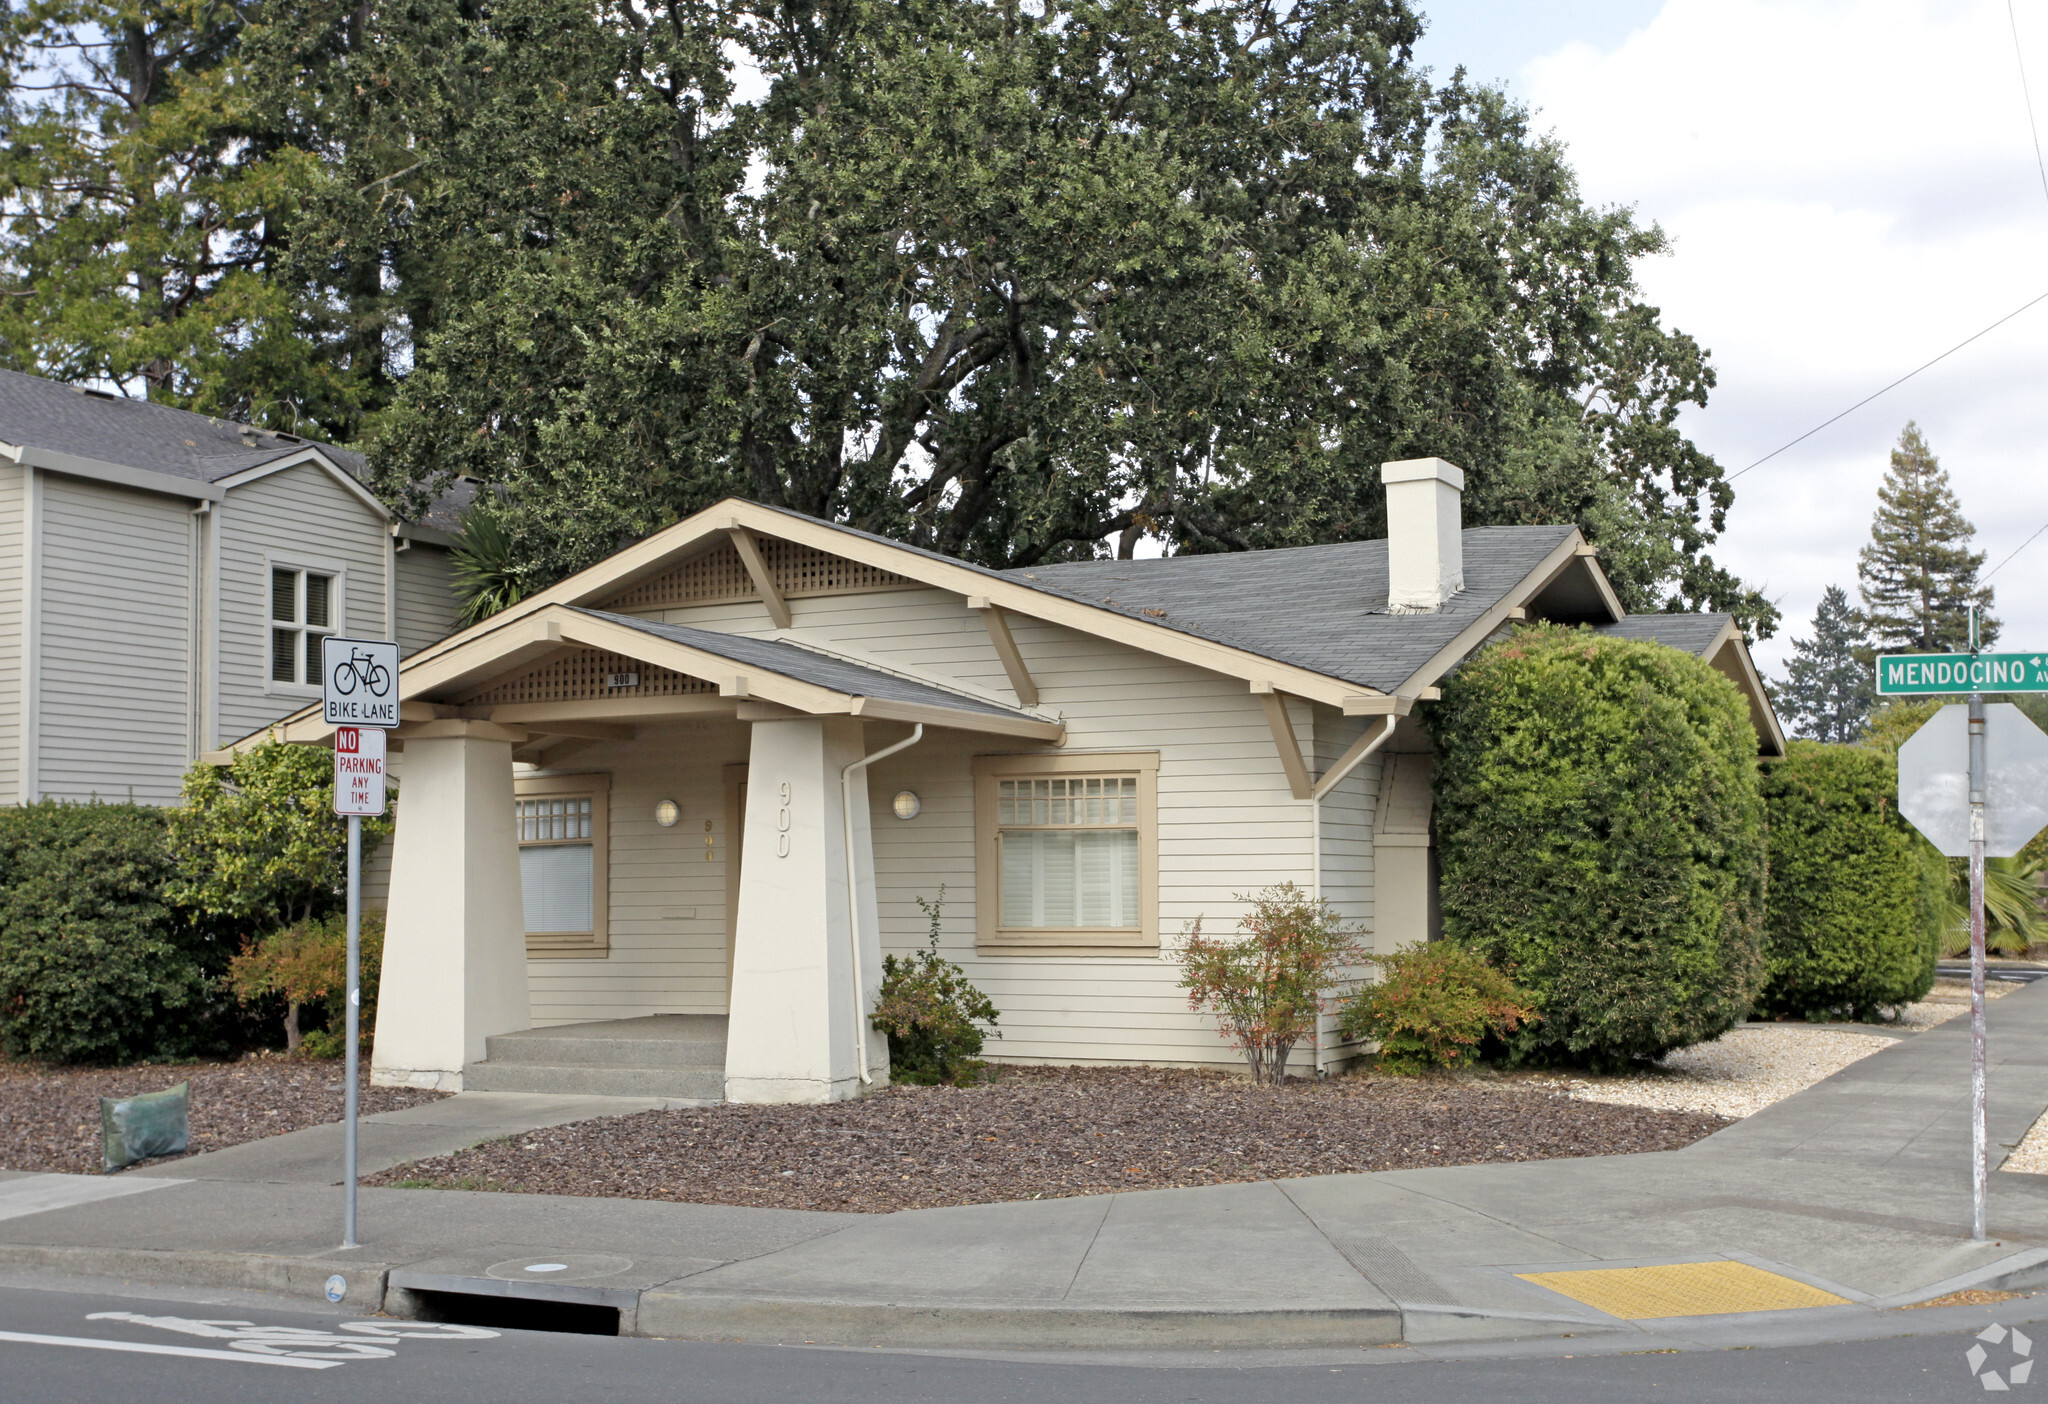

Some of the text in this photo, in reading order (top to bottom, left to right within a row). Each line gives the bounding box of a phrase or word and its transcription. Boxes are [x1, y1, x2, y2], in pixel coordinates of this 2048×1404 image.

[613, 674, 630, 685] 900
[1888, 660, 2025, 685] MENDOCINO
[330, 701, 394, 720] BIKE LANE
[339, 730, 357, 750] NO
[339, 756, 382, 775] PARKING
[351, 777, 369, 789] ANY
[351, 791, 369, 805] TIME
[776, 780, 791, 859] 900
[704, 819, 714, 862] 900
